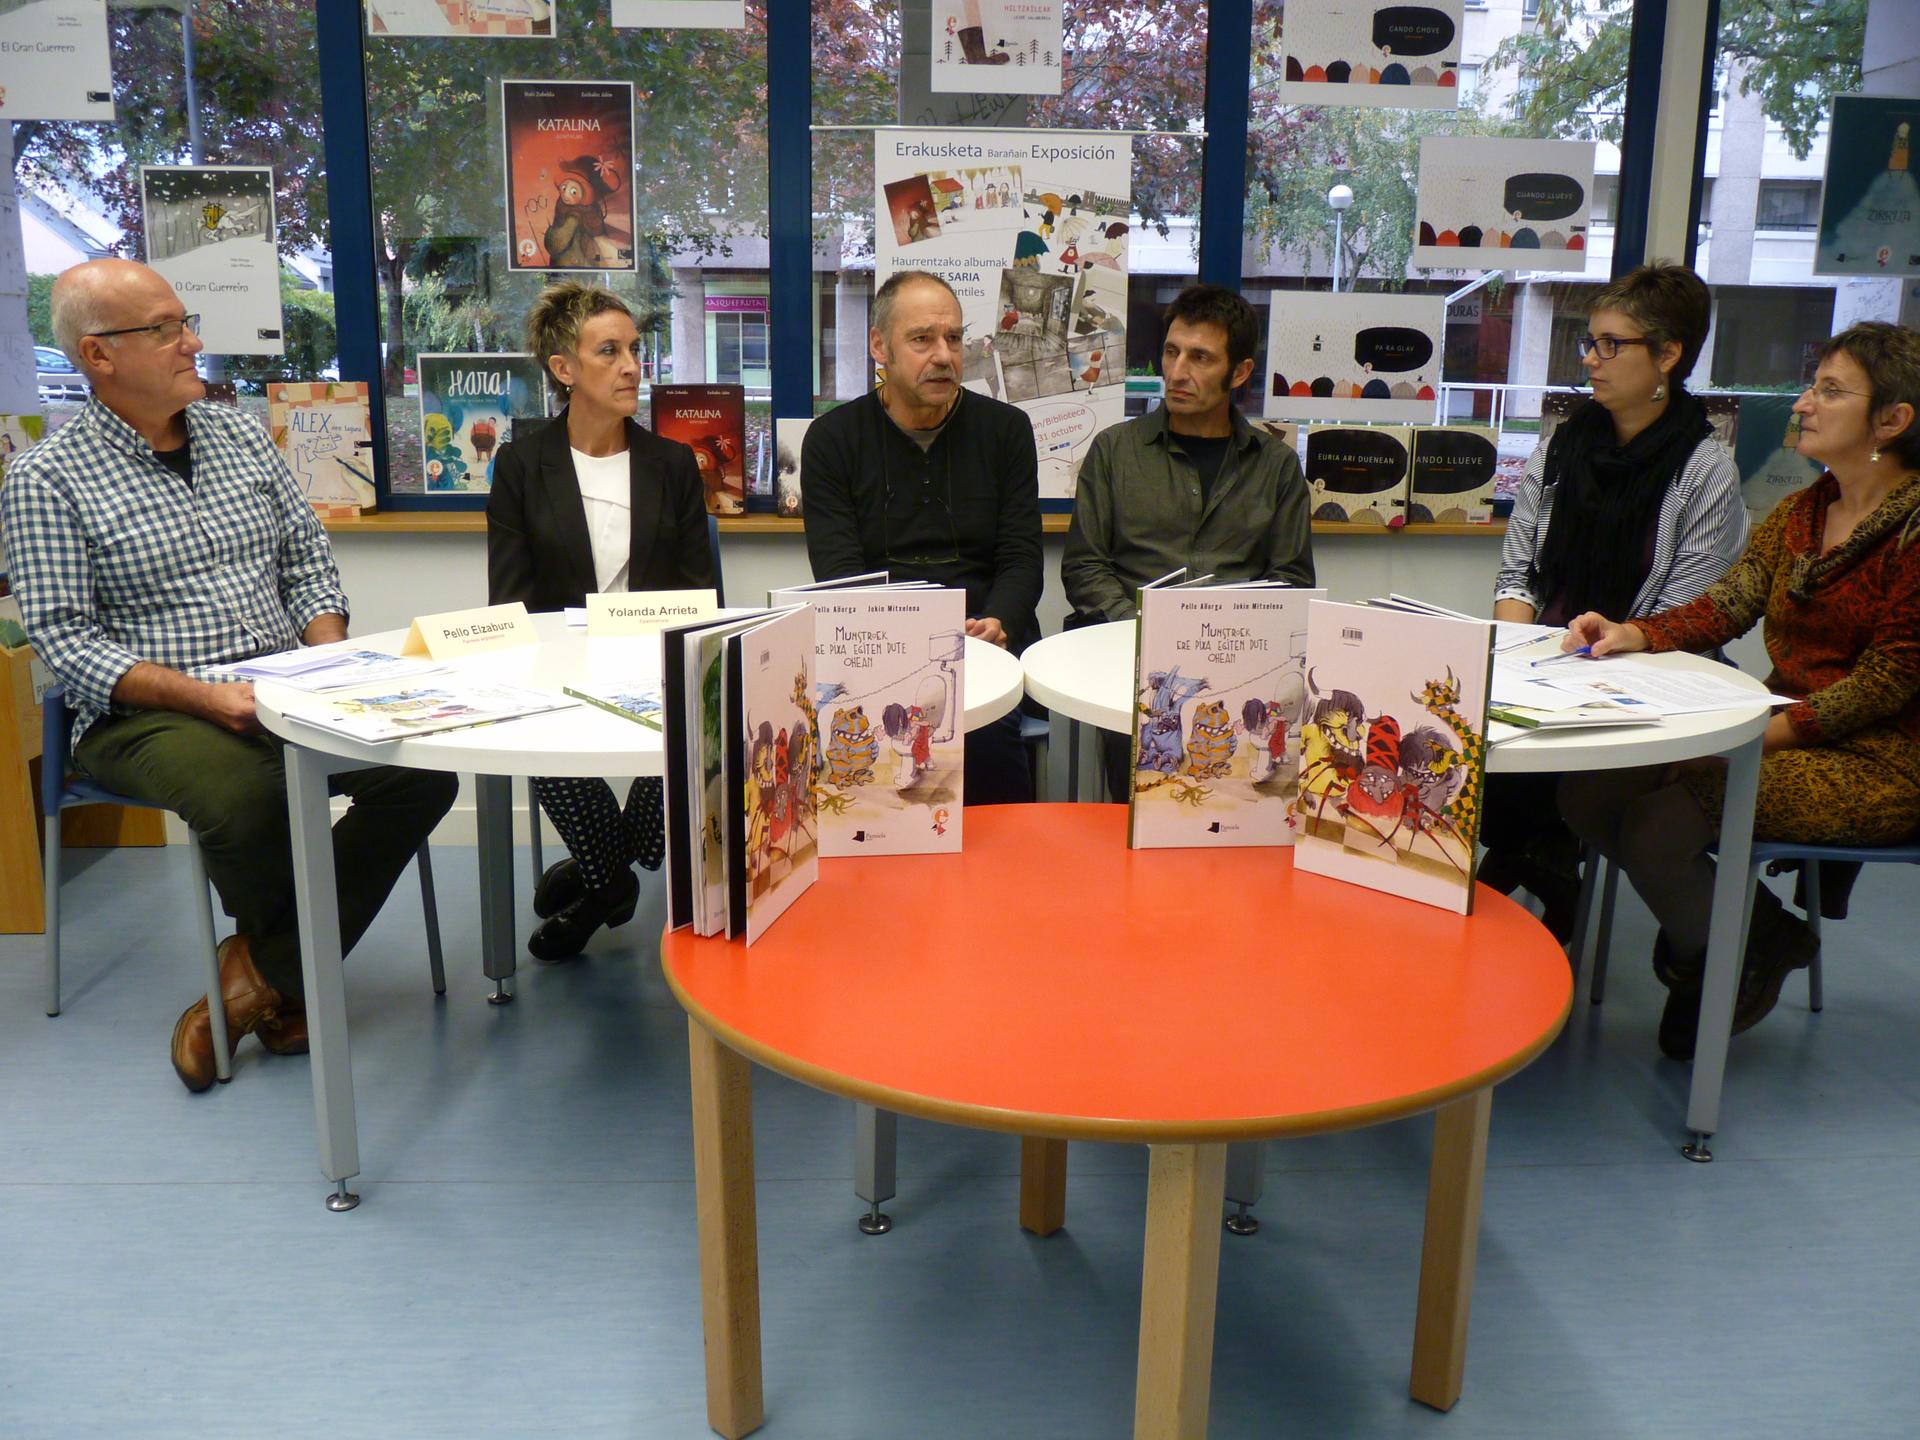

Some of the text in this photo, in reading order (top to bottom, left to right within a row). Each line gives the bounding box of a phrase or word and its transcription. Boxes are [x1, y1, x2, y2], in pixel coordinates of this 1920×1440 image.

[1416, 26, 1440, 34] CHOVE
[1, 41, 75, 53] El Gran Guerrero
[537, 119, 601, 131] KATALINA
[896, 142, 1115, 162] Erakusketa Barañain Exposición
[1516, 191, 1575, 200] CUANDO LLUEVE
[891, 256, 1008, 267] Haurrentzako albumak
[948, 272, 980, 282] SARIA
[175, 281, 249, 292] O Gran Guerreiro
[448, 369, 511, 397] Hara!
[675, 409, 722, 419] KATALINA
[292, 412, 332, 433] ALEX
[1051, 423, 1083, 438] octubre
[1318, 453, 1395, 464] EURIA ARI DUENEAN
[1416, 455, 1483, 465] ANDO LLUEVE
[608, 606, 698, 617] Yolanda Arrieta
[887, 605, 920, 613] Mitxelena
[443, 627, 470, 639] Pello
[835, 626, 888, 643] MUNSTROEK
[1201, 623, 1251, 640] MUNSTROEK
[854, 642, 882, 655] EGITEN
[887, 642, 907, 655] DUTE
[1176, 640, 1191, 650] ERE
[1217, 638, 1245, 651] EGITEN
[1250, 638, 1268, 651] DUTE
[843, 657, 873, 668] OHEAN
[1207, 653, 1236, 663] OHEAN
